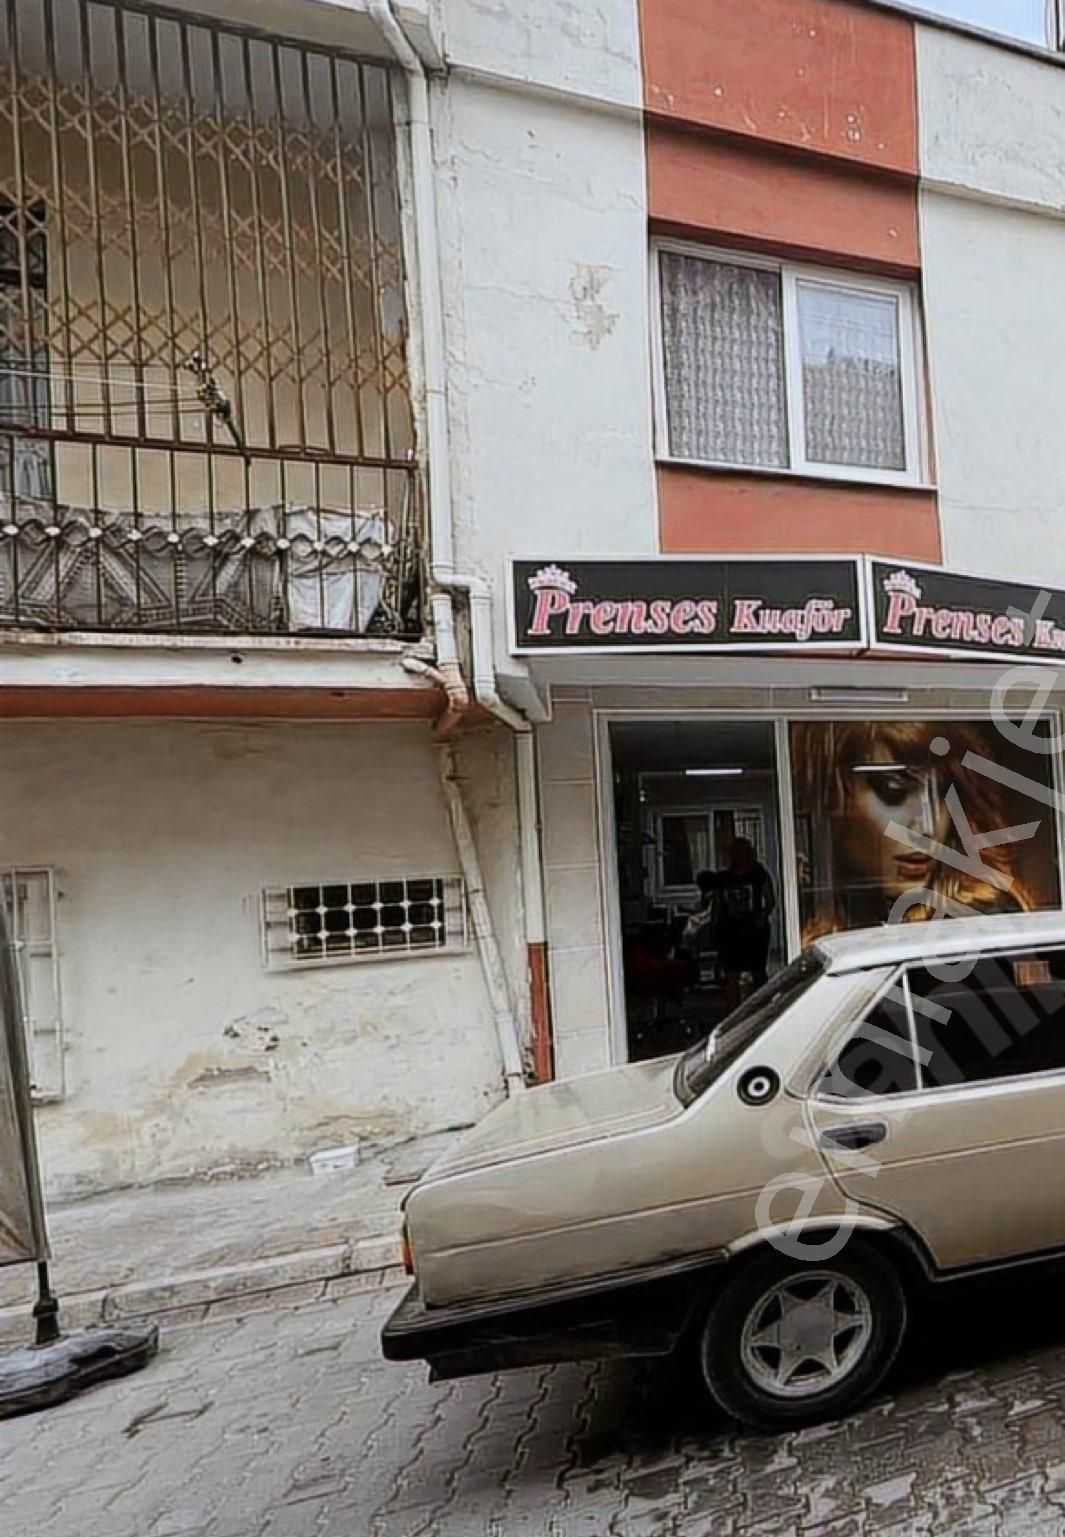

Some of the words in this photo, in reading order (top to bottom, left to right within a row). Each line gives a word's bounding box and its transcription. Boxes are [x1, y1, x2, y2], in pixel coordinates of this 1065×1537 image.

[527, 586, 719, 637] Prenses
[729, 599, 852, 642] Kuaför
[881, 592, 1026, 646] Prenses
